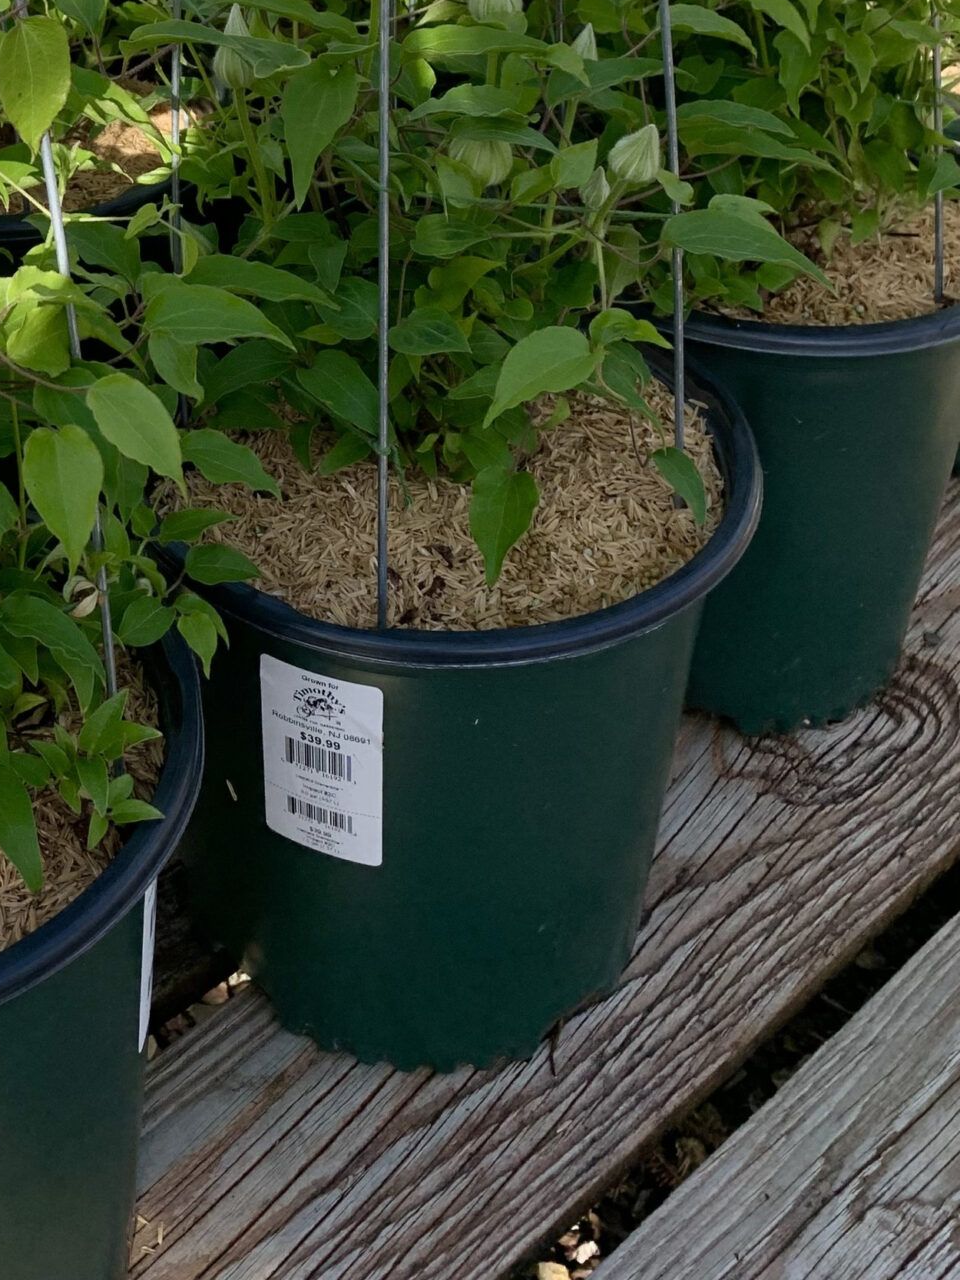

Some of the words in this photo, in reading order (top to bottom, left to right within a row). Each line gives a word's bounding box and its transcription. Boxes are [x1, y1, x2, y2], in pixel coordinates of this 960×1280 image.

[300, 674, 327, 688] Grown
[328, 682, 339, 690] for
[300, 731, 341, 751] $39.99
[328, 730, 341, 739] NJ
